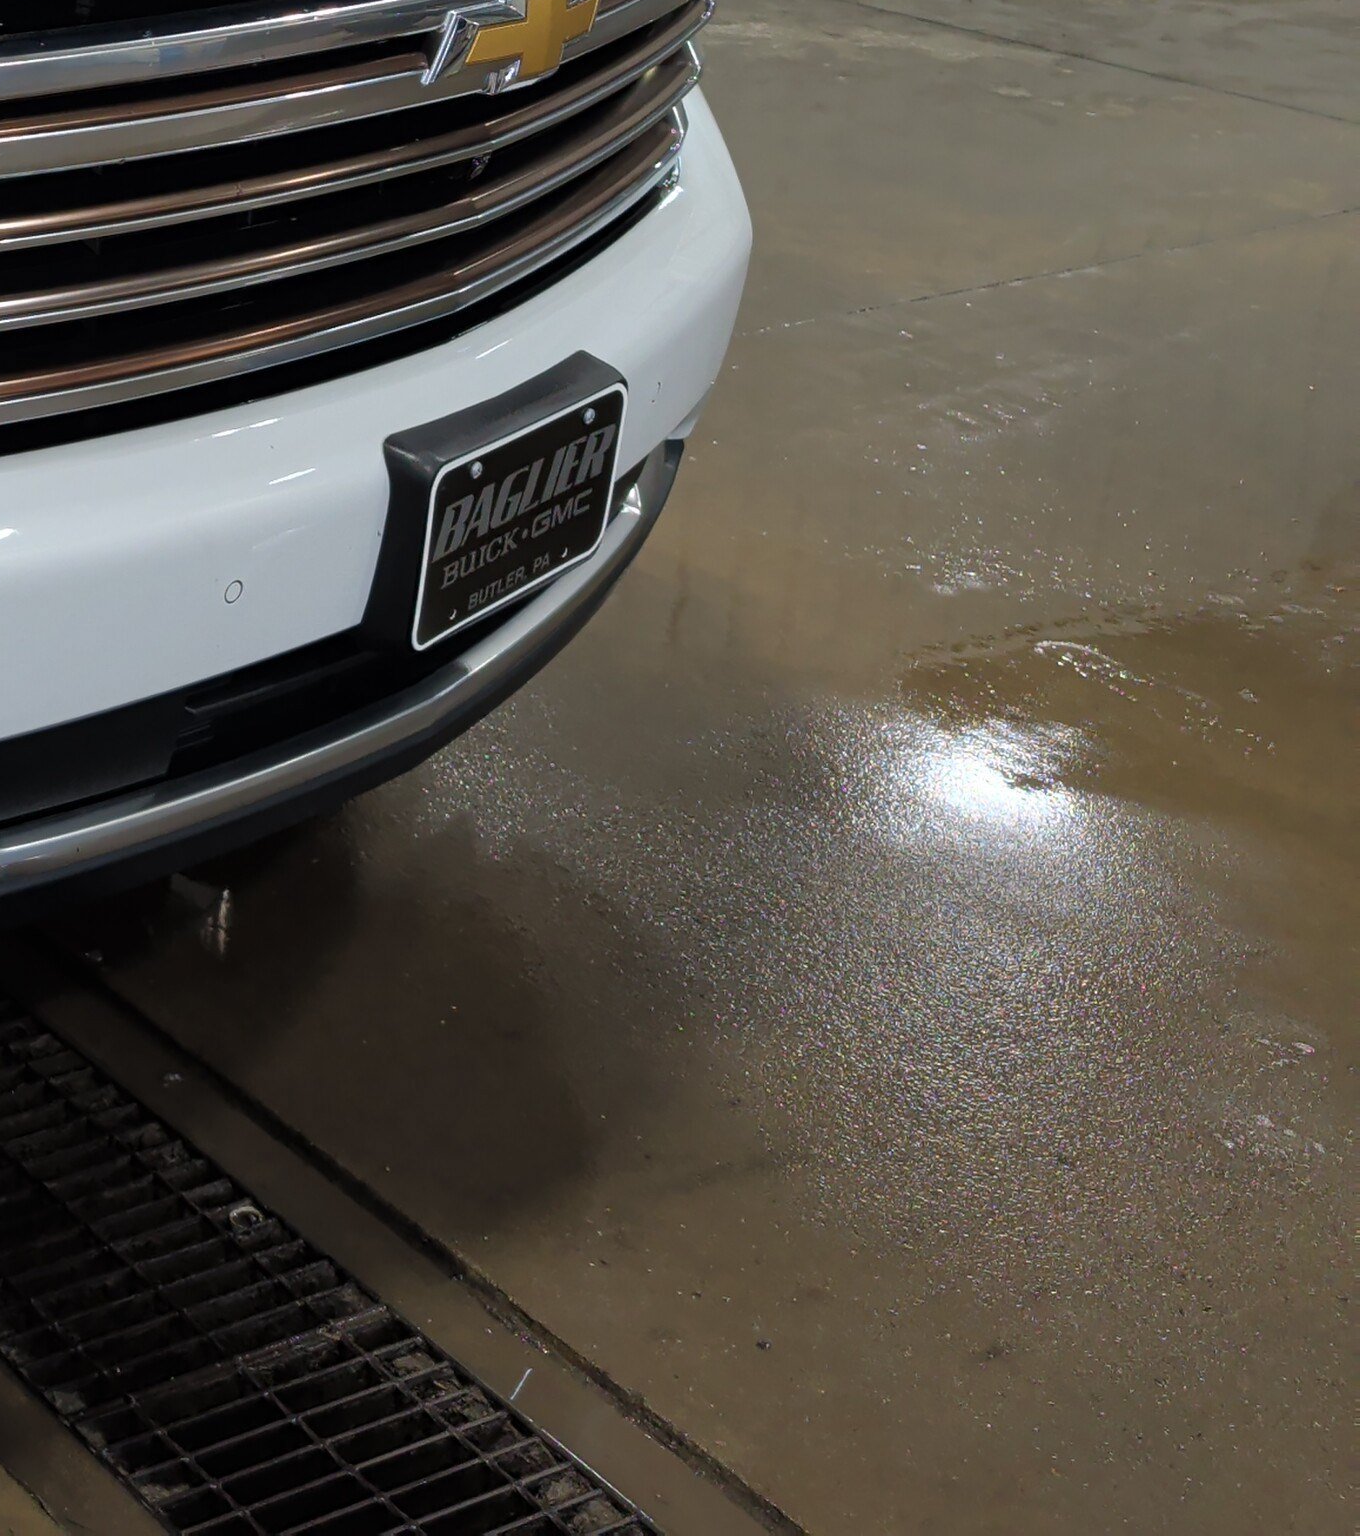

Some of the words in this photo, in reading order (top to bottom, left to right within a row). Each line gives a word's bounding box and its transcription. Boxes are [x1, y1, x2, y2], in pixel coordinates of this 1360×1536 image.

[432, 423, 617, 563] BAGLIER
[440, 526, 520, 590] BUICK
[531, 488, 594, 539] GMC
[532, 552, 551, 574] PA
